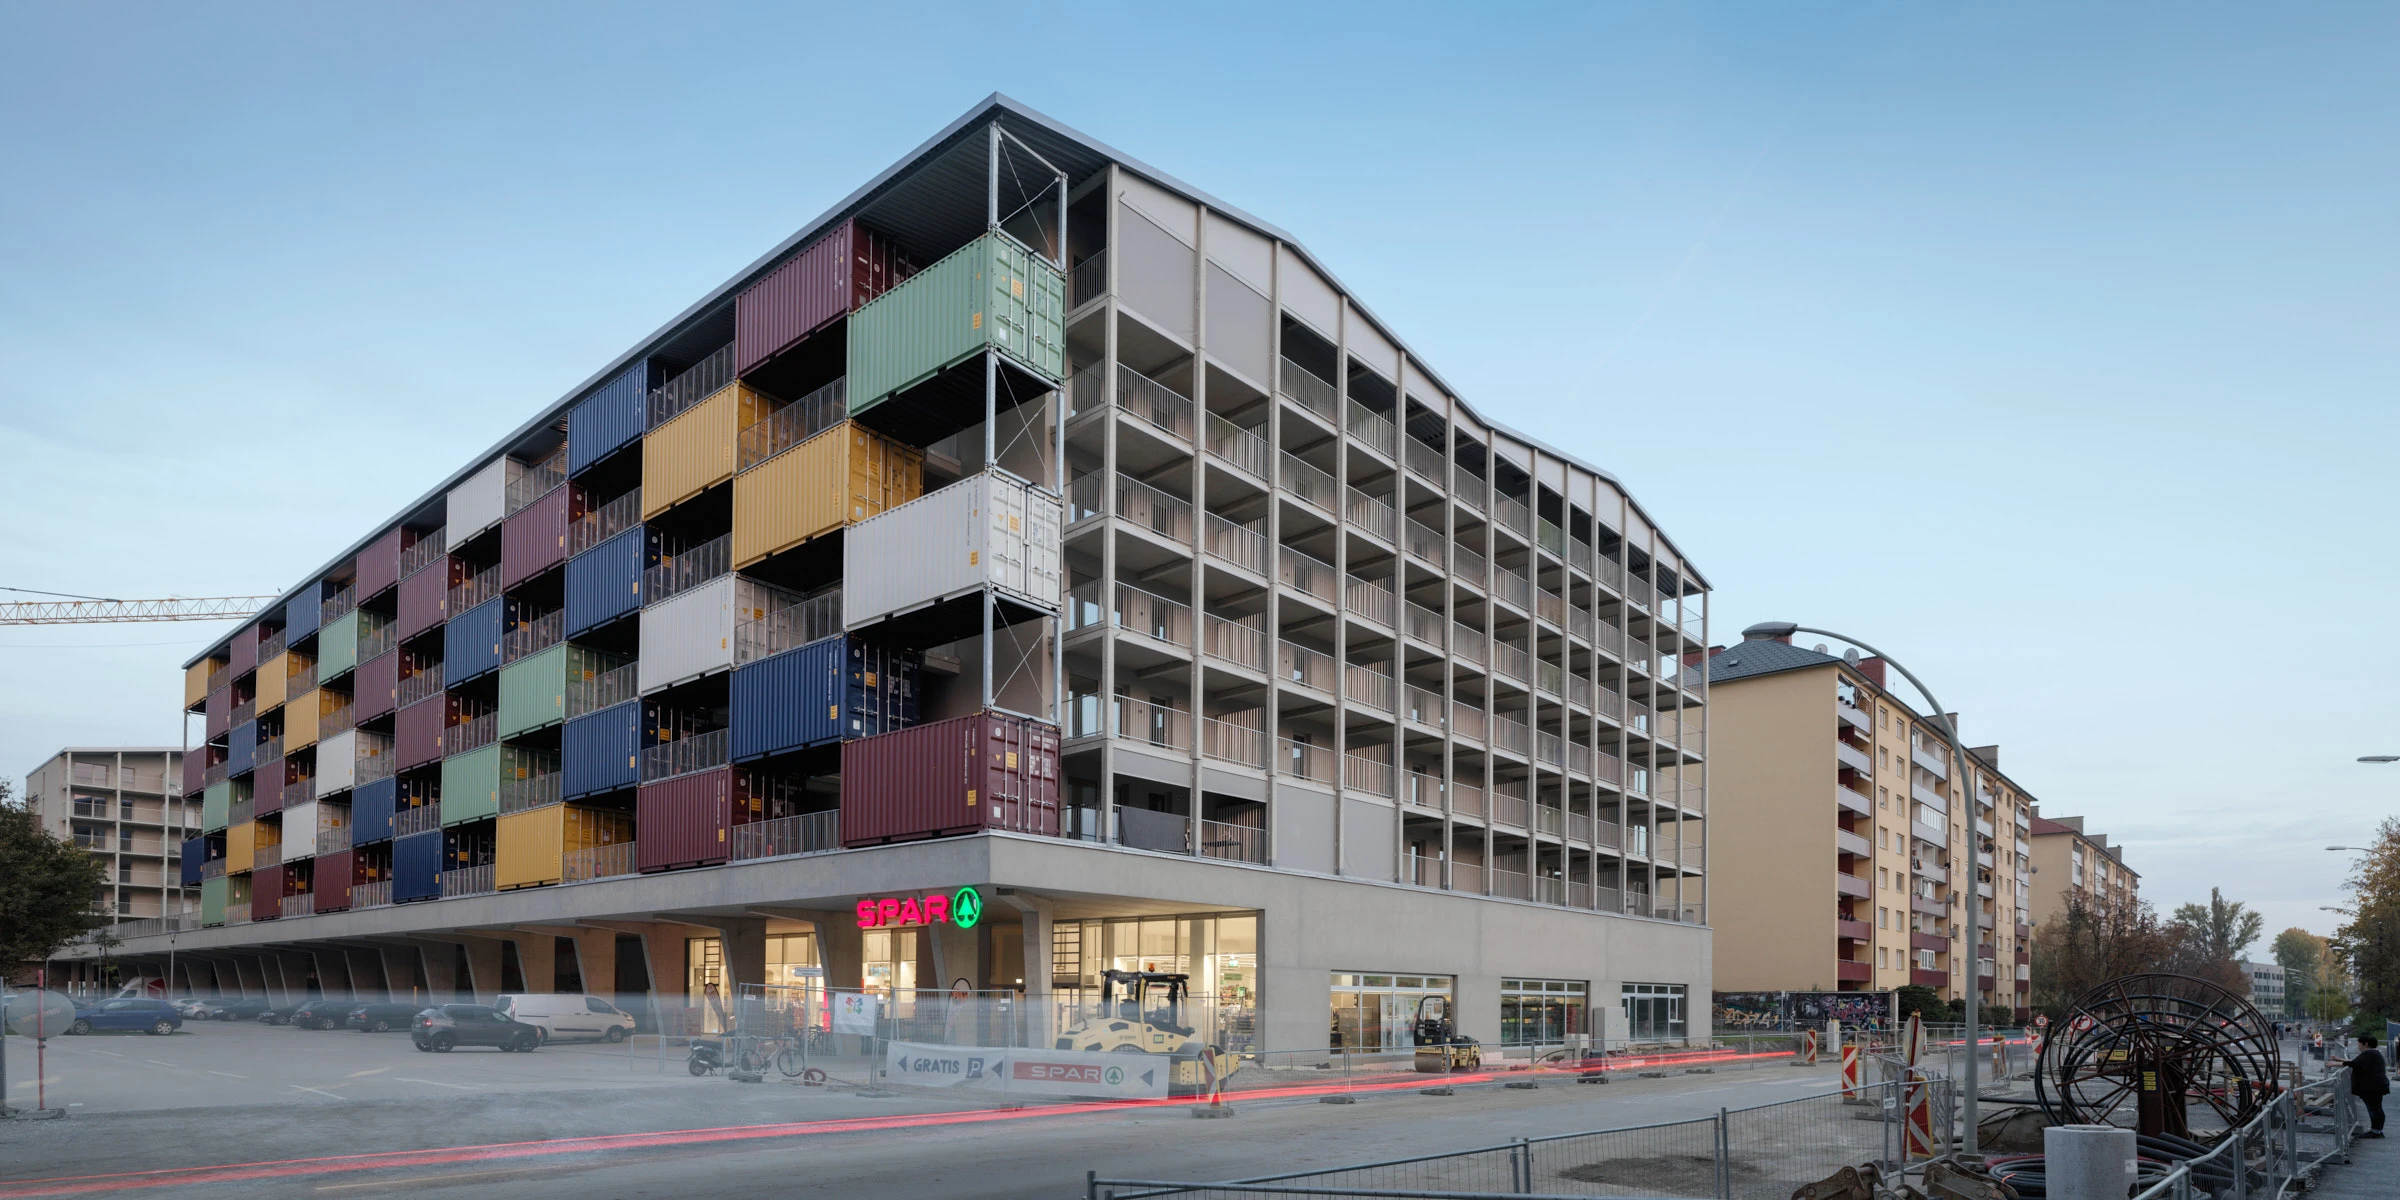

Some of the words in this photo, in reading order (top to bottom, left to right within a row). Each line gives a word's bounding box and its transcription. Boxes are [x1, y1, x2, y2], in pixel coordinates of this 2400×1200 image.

[857, 895, 949, 928] SPAR
[913, 1058, 960, 1075] GRATIS
[1031, 1065, 1100, 1081] SPAR
